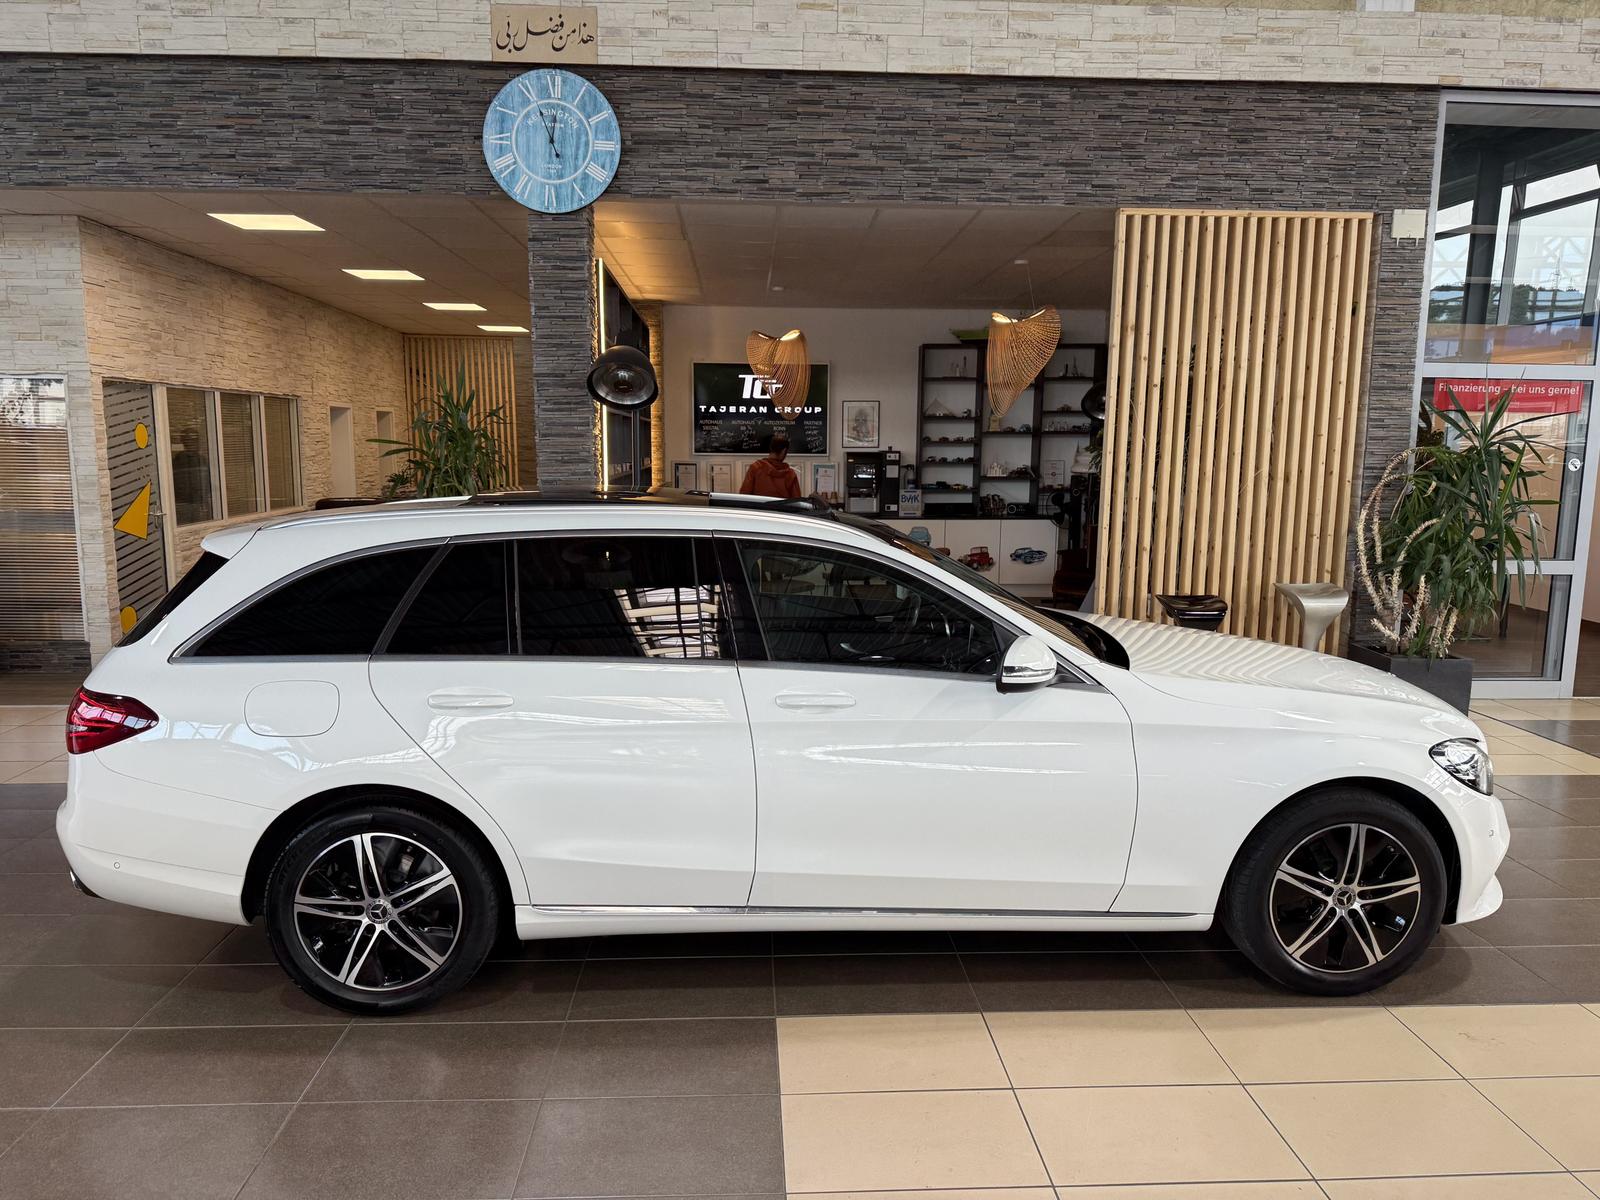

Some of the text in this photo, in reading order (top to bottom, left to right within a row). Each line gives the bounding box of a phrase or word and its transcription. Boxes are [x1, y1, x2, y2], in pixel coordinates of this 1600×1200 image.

[512, 13, 565, 51] فضل
[551, 28, 577, 52] من
[1438, 382, 1501, 395] Finanzierung
[1528, 386, 1546, 394] uns
[1547, 386, 1580, 395] gerne!
[699, 405, 822, 414] TAJERAN GROUP
